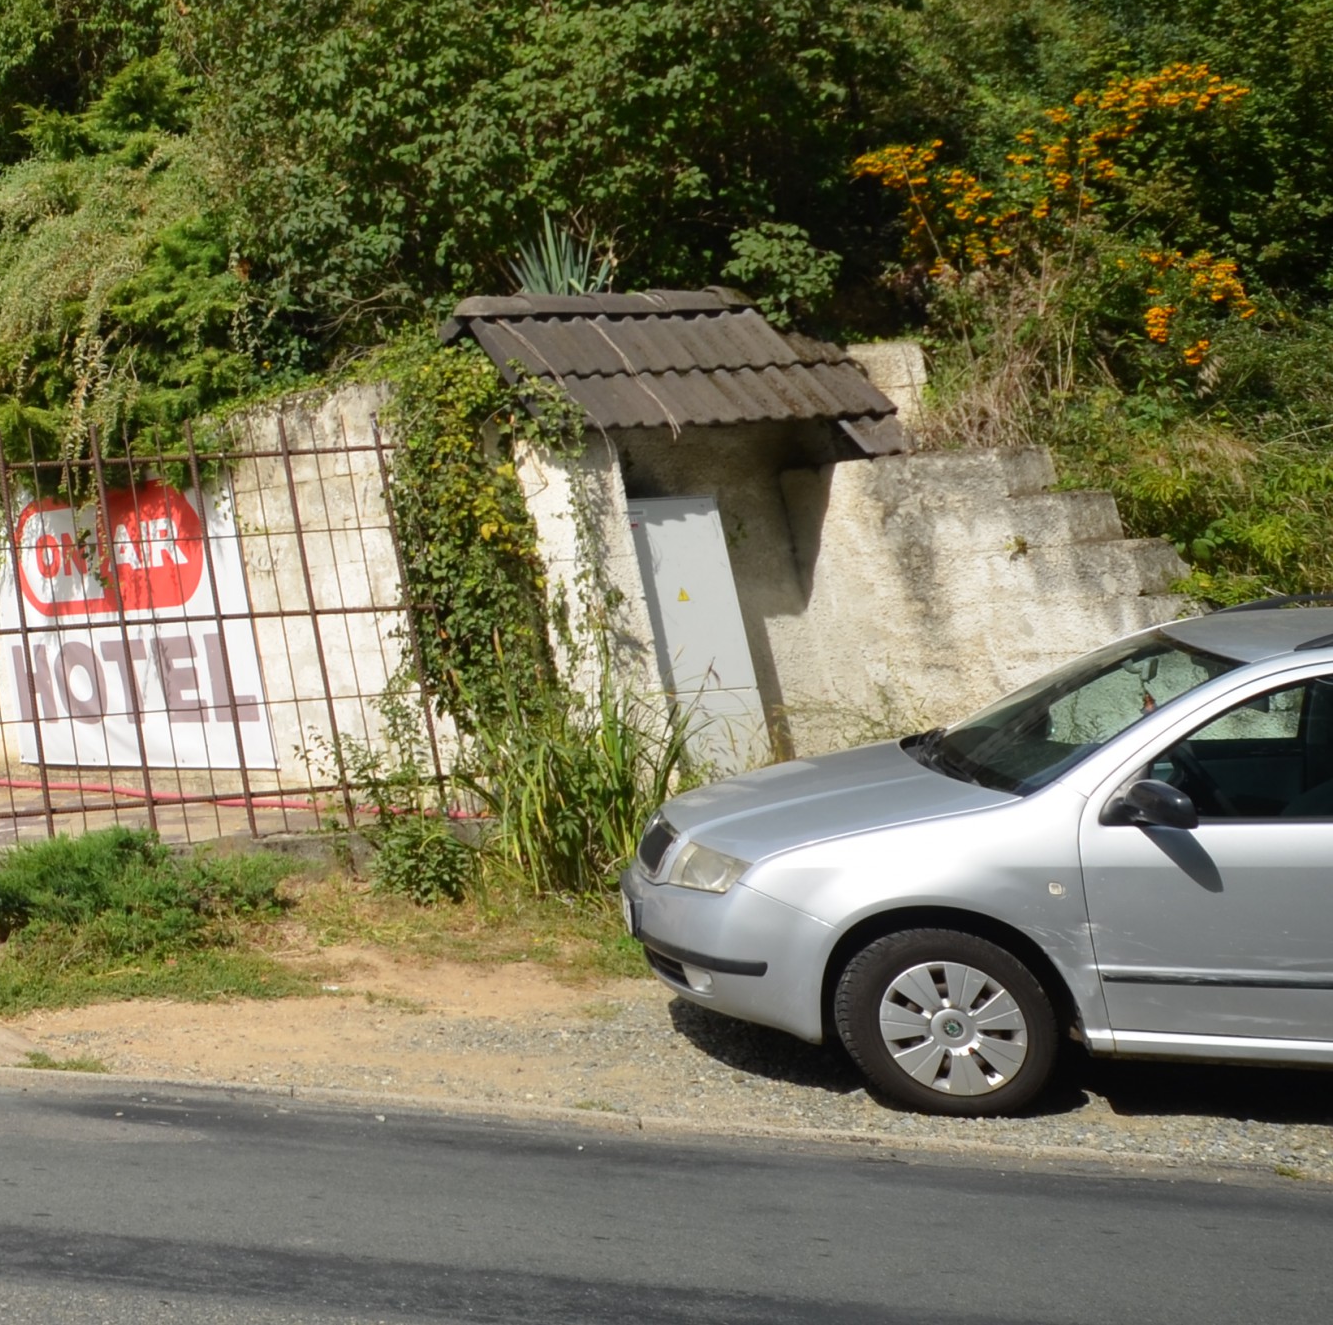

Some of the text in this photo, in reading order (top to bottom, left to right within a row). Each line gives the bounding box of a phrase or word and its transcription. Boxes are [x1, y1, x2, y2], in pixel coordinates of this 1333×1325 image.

[36, 518, 188, 579] ON AIR
[11, 633, 261, 725] HOTEL
